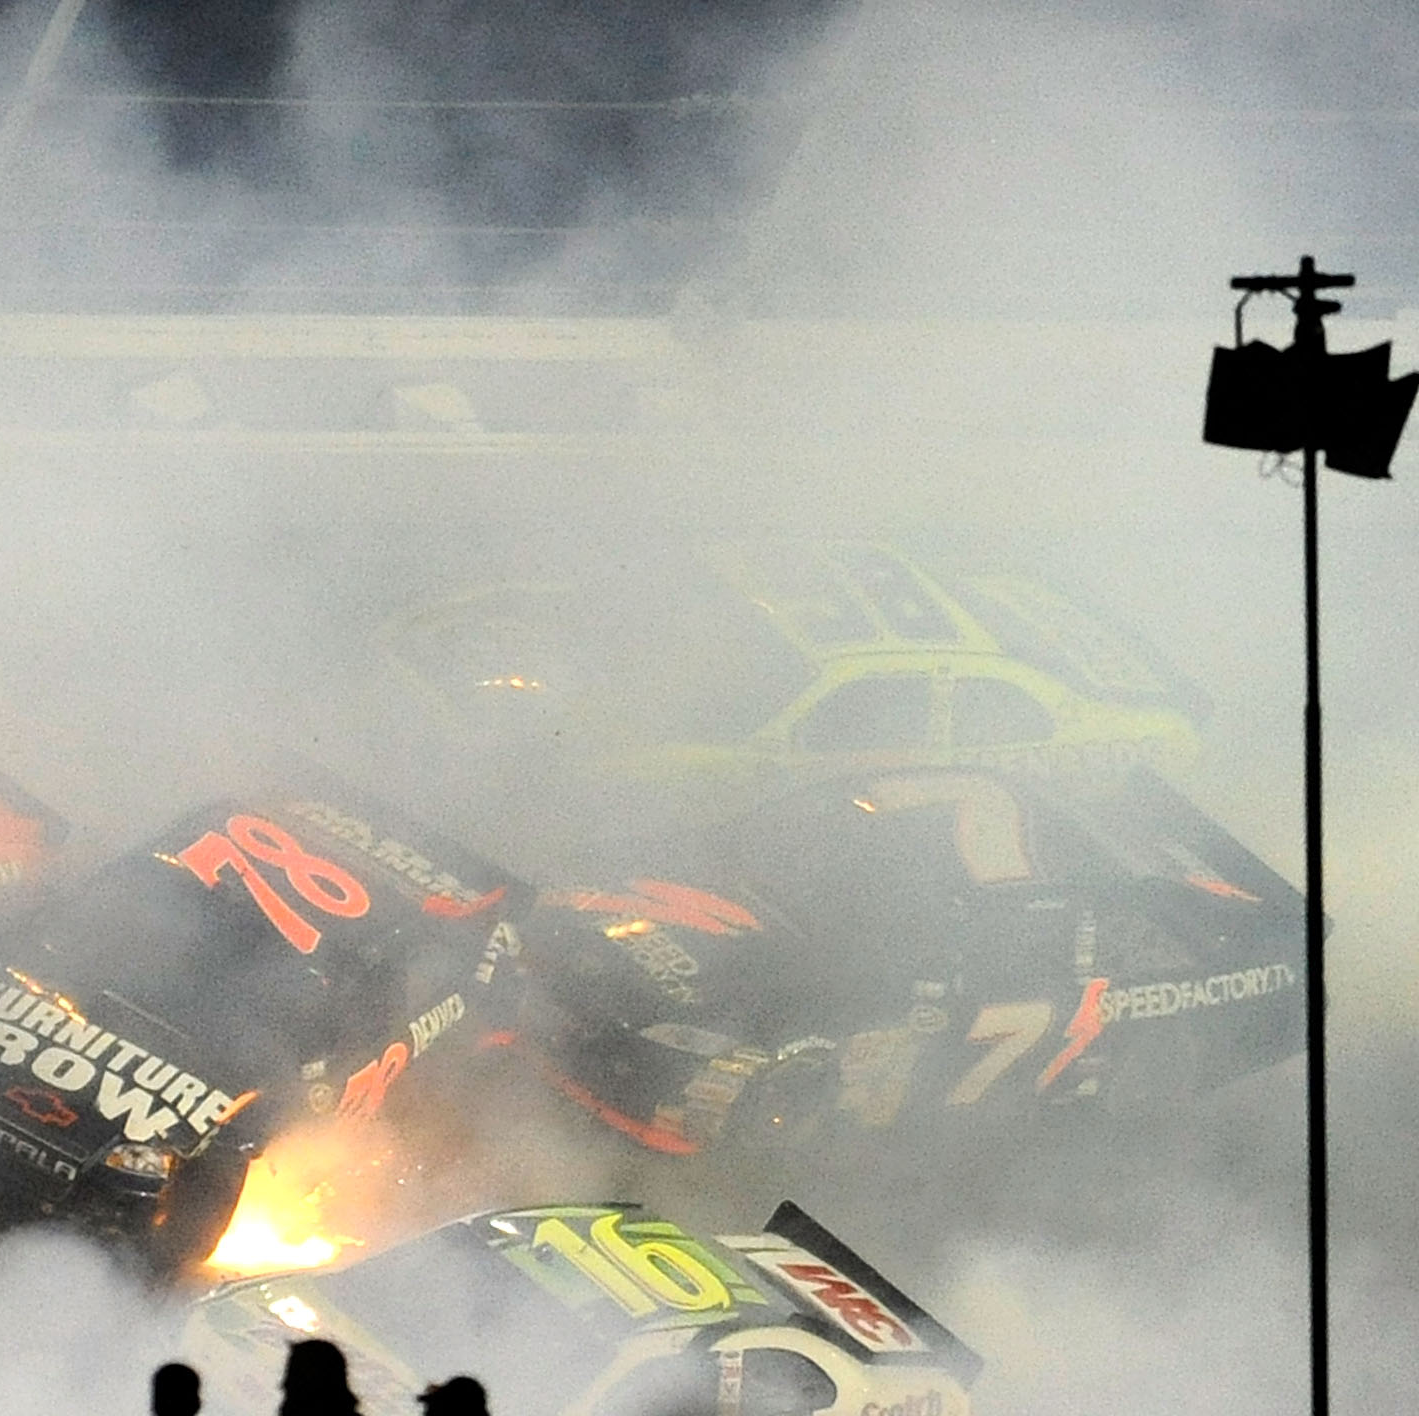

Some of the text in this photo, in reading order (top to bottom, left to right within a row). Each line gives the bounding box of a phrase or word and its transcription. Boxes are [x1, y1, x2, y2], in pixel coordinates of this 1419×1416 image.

[177, 814, 371, 954] 78
[947, 1000, 1055, 1106] 7
[533, 1213, 732, 1319] 16
[775, 1260, 915, 1348] 3M
